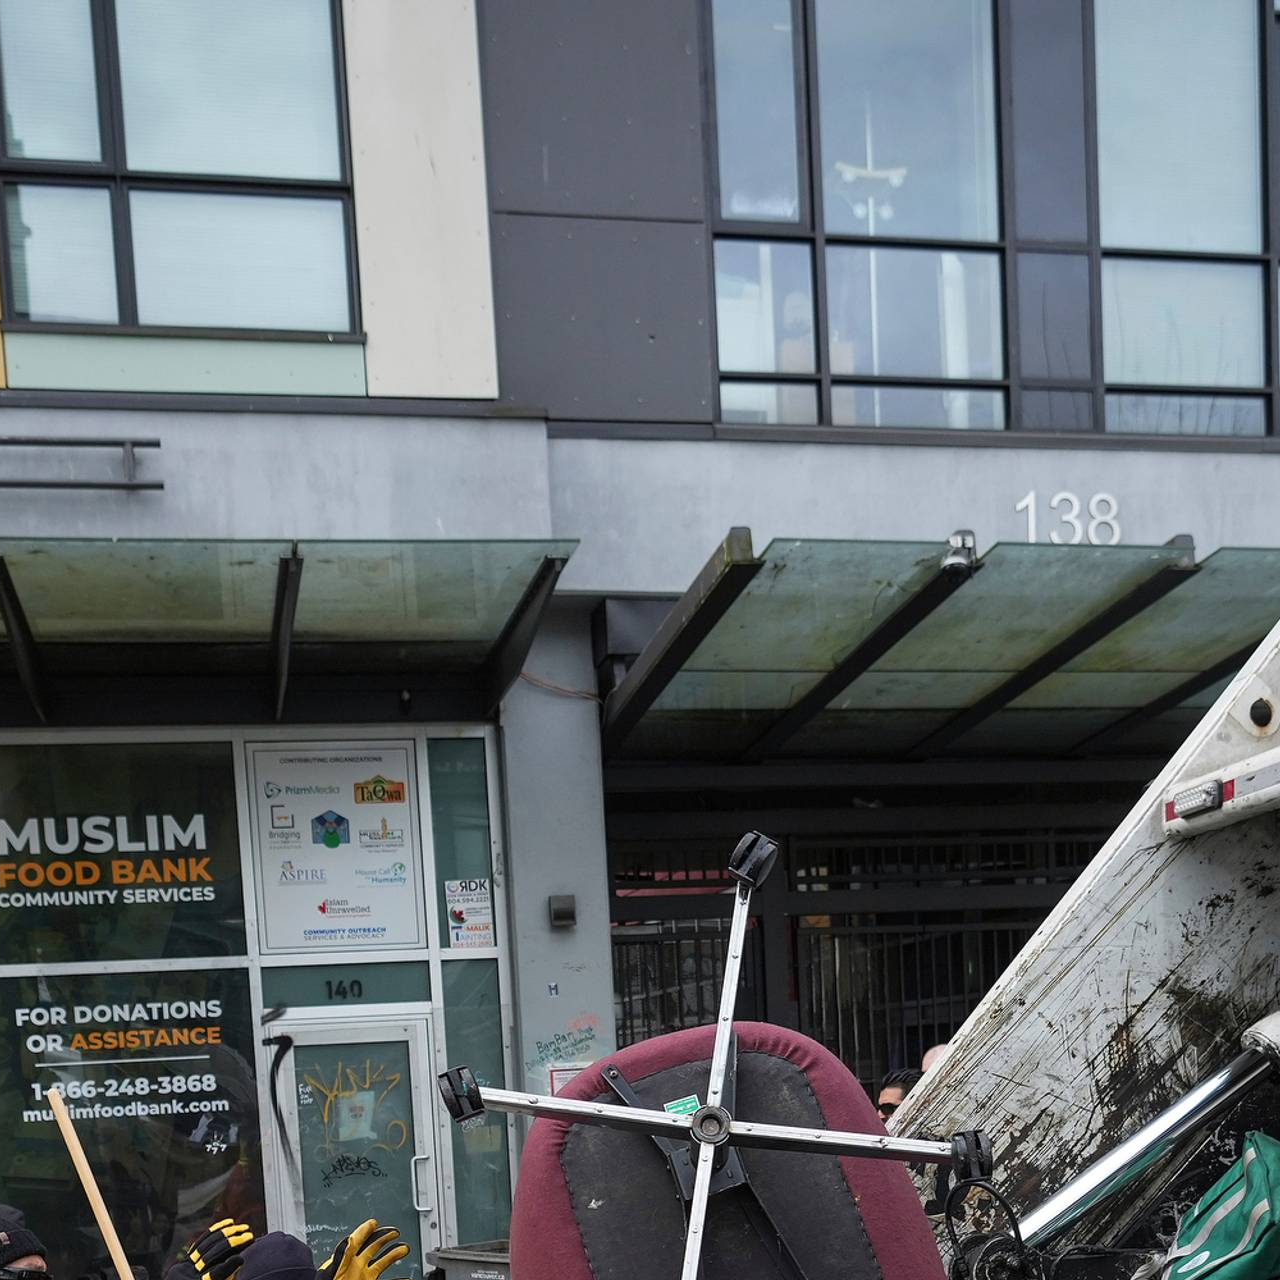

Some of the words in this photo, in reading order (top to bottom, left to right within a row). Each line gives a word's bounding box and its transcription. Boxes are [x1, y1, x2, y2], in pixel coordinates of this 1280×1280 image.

[1015, 489, 1121, 546] 138
[111, 856, 215, 885] BANK
[279, 868, 327, 881] ASPIRE
[122, 886, 216, 904] SERVICES
[303, 928, 346, 936] COMMUNITY
[348, 927, 387, 935] OUTREACH
[325, 979, 364, 1001] 140
[15, 1006, 67, 1027] FOR
[74, 1000, 223, 1025] DONATIONS
[25, 1034, 64, 1054] OR
[70, 1026, 223, 1051] ASSISTANCE
